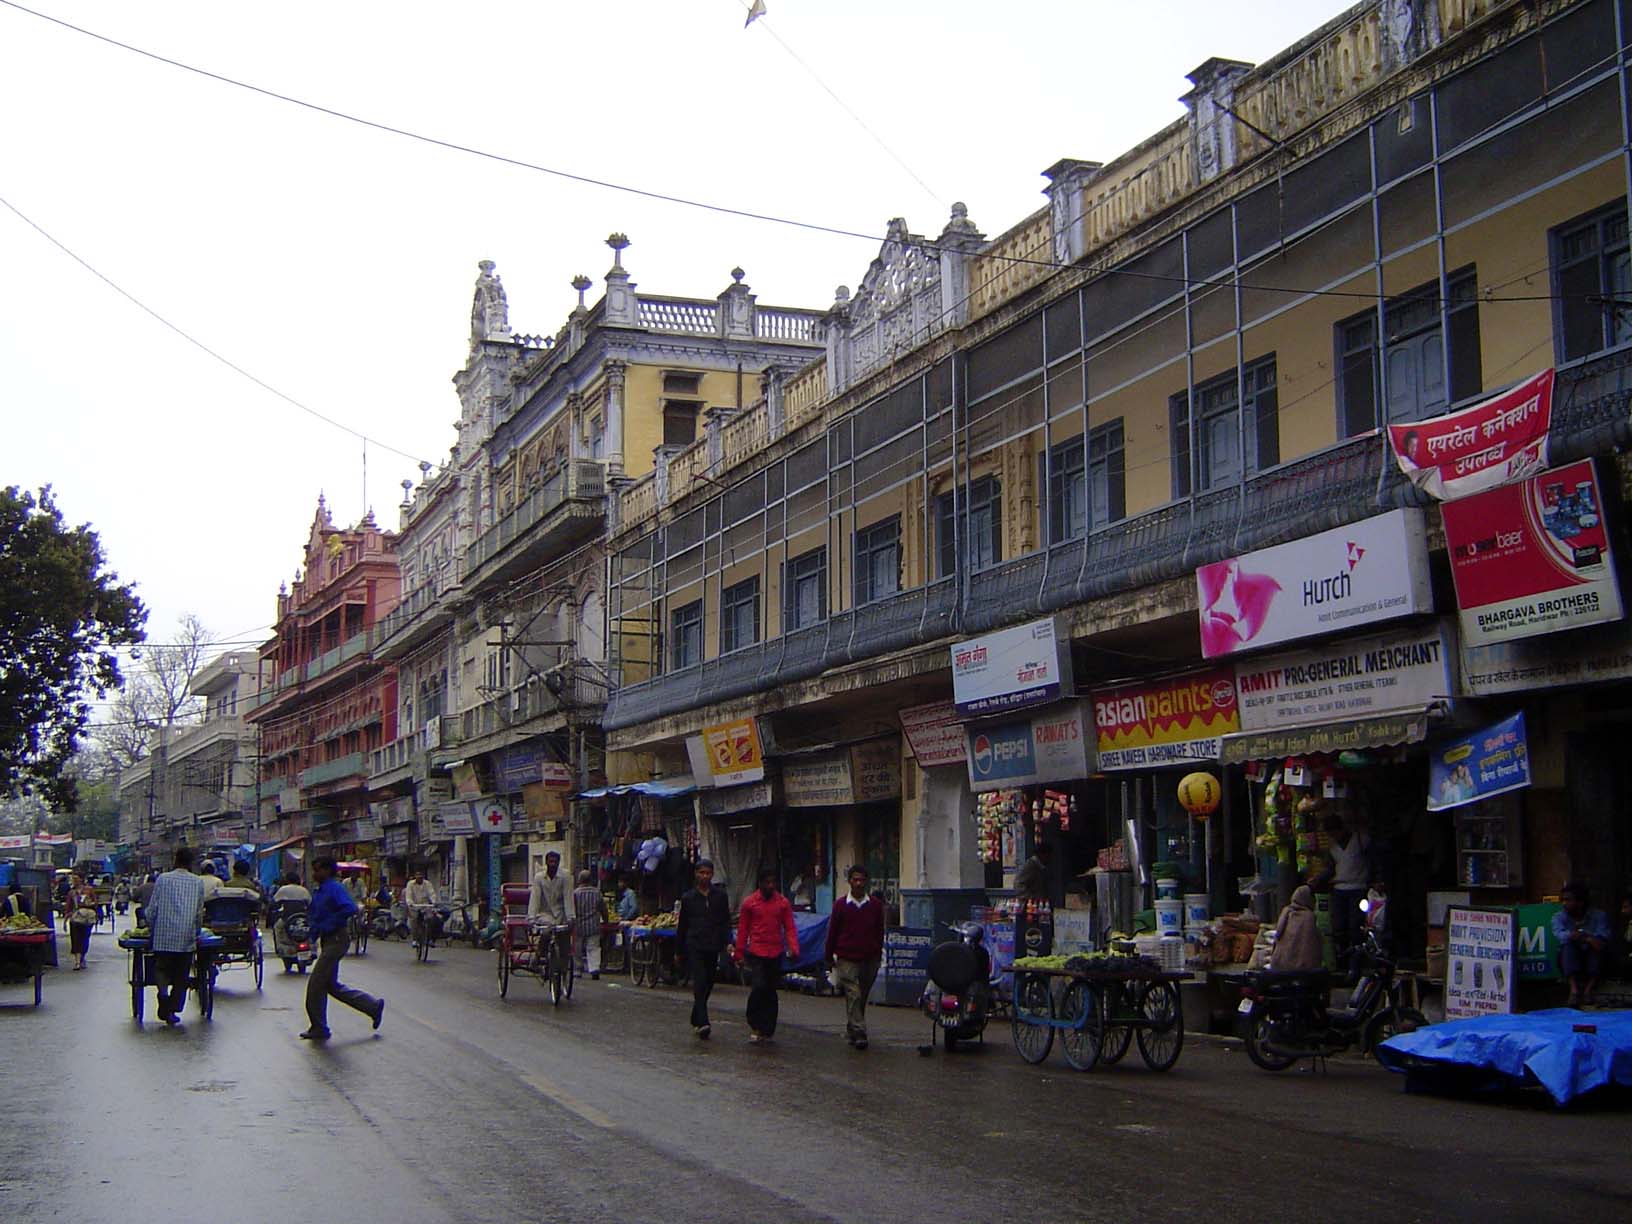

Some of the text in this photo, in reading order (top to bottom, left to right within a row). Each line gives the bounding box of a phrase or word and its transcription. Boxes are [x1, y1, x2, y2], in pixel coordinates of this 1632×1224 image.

[1427, 394, 1540, 458] एयरटेल कनेक्शन
[1478, 591, 1599, 626] BHARGAVA BROTHERS
[1482, 621, 1507, 634] Railway
[1240, 670, 1282, 693] AMIT
[1365, 640, 1440, 673] MERCHANT
[1036, 719, 1078, 745] RAWAT'S
[994, 738, 1028, 762] PEPSI
[1102, 751, 1120, 768] SHREE
[1121, 748, 1146, 765] NAVEEN
[1190, 739, 1217, 757] STORE
